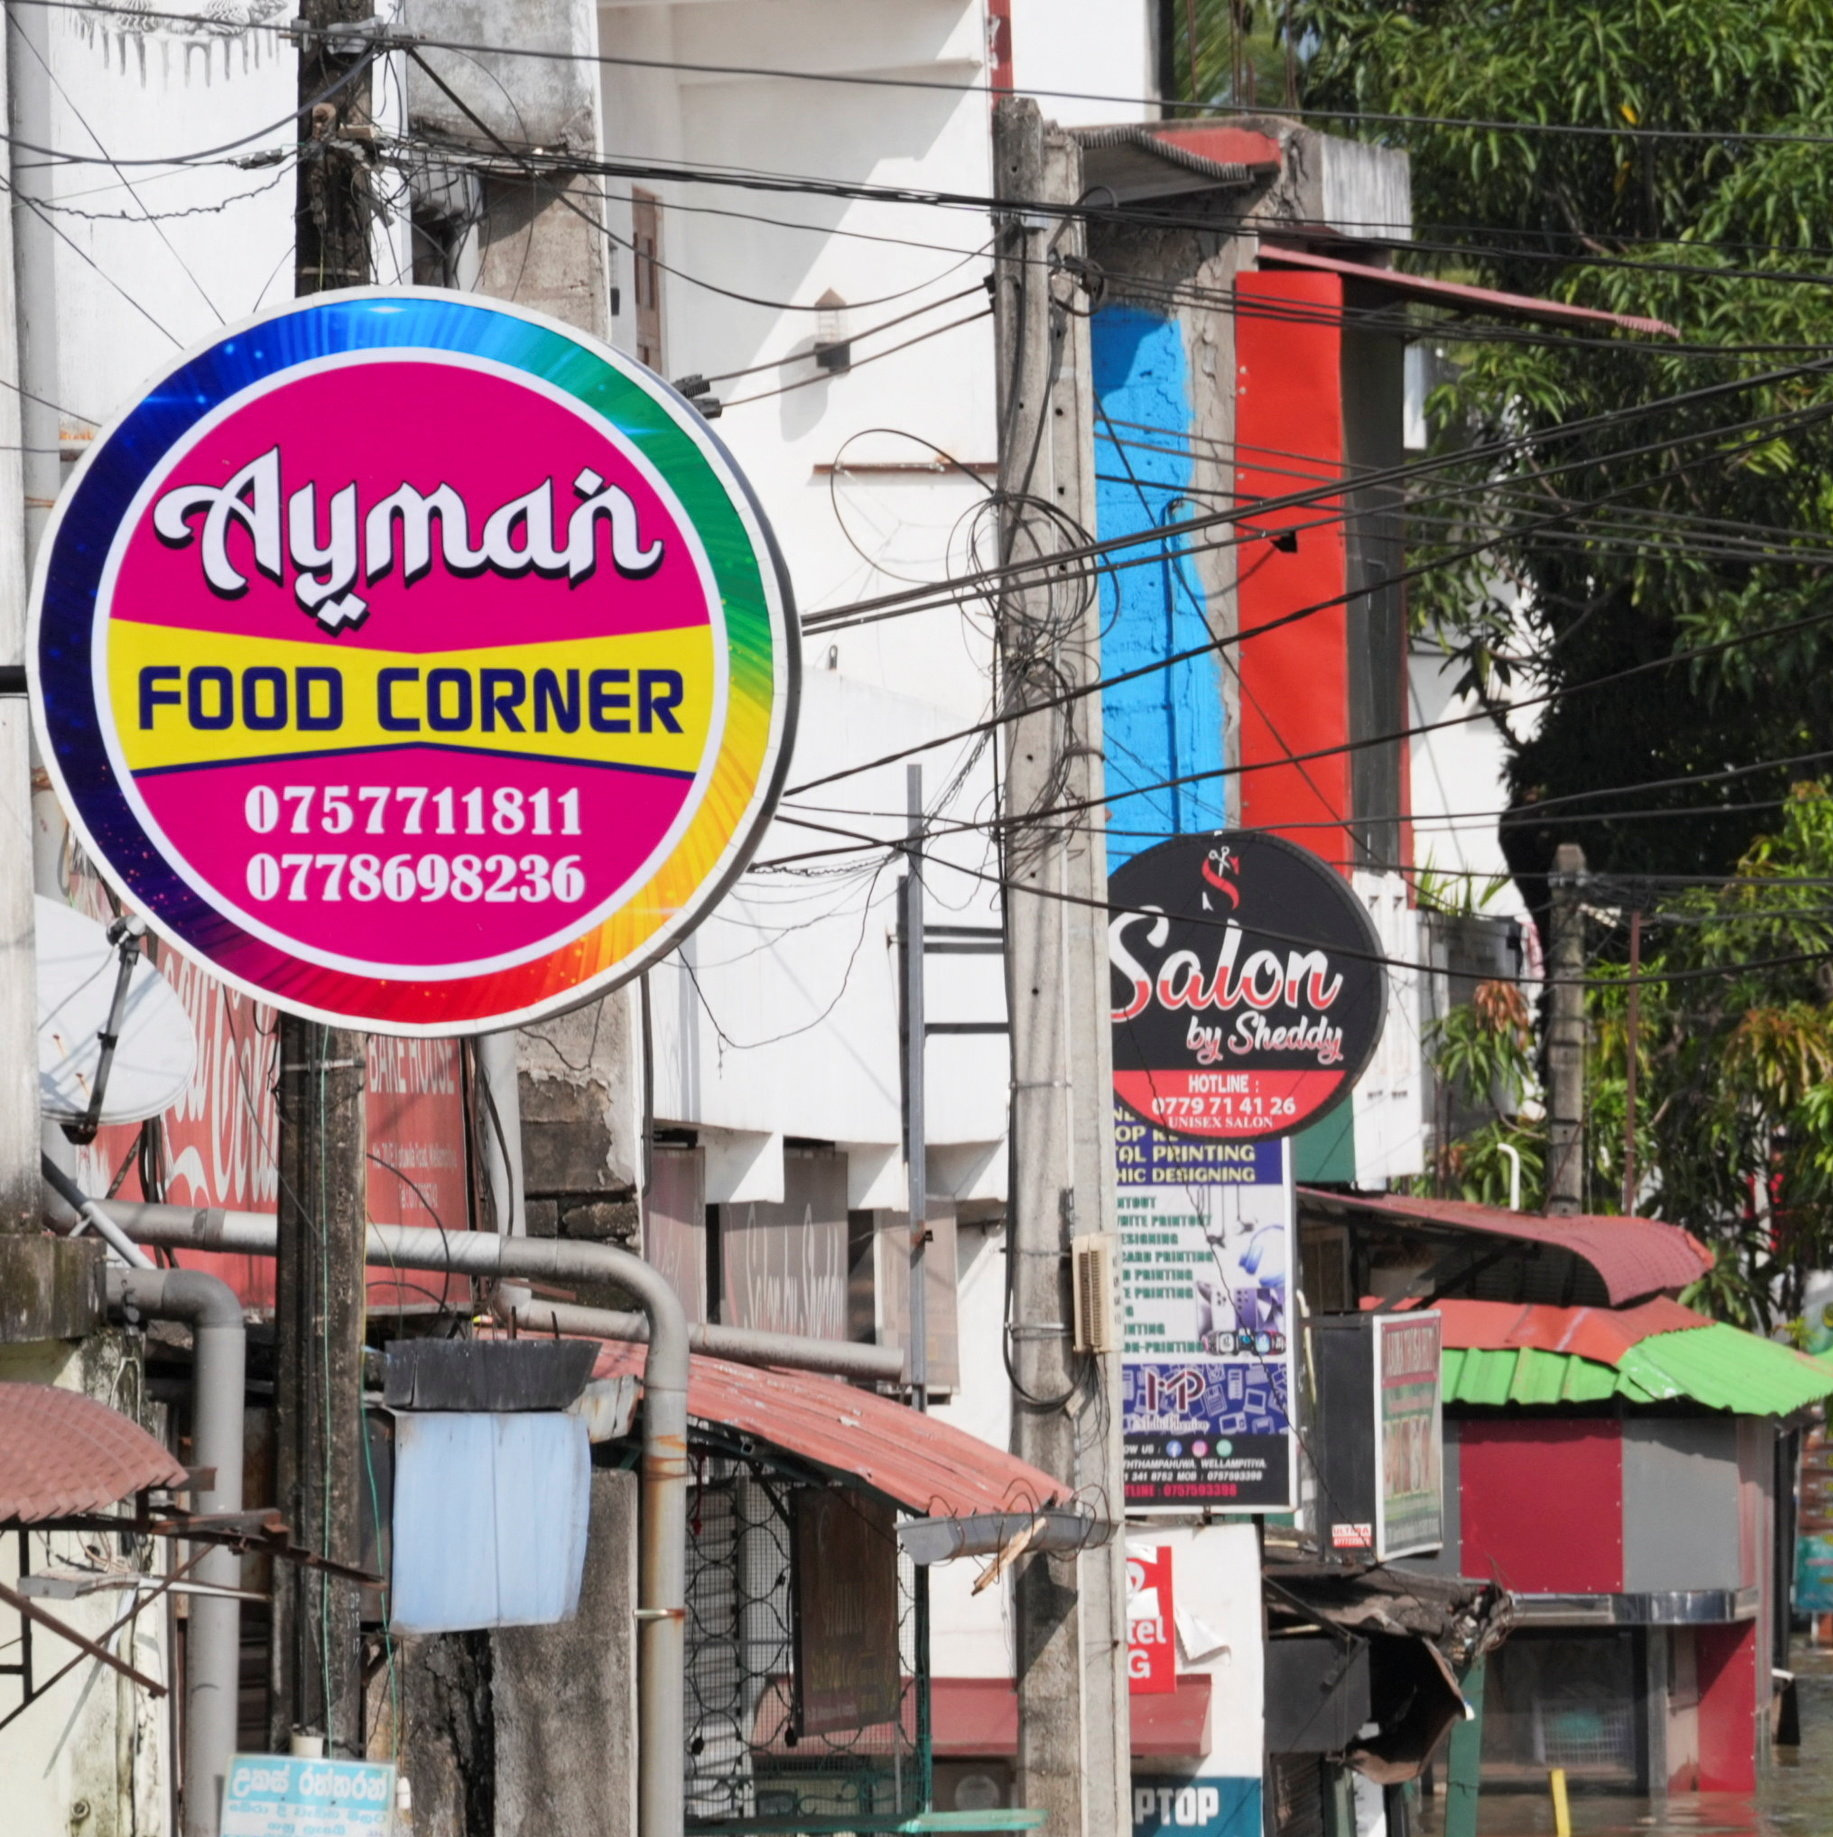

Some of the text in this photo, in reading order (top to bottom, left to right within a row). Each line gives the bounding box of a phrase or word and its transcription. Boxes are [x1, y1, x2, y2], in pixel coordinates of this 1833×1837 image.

[153, 445, 664, 635] Ayman
[138, 665, 685, 734] FOOD CORNER
[244, 784, 582, 836] 0757711811
[246, 853, 586, 904] 0778698236
[1109, 905, 1343, 1023] Salon
[1186, 1011, 1344, 1065] by Sheddy
[1188, 1075, 1249, 1093] HOTLINE
[1152, 1098, 1206, 1115] 0779
[1210, 1098, 1234, 1115] 71
[1240, 1098, 1264, 1115] 41
[1271, 1098, 1296, 1115] 26
[1169, 1116, 1274, 1129] UNISEX SALON
[1116, 1145, 1256, 1162] AL PRINTING
[1153, 1168, 1256, 1183] DESIGNING
[1155, 1251, 1214, 1263] PRINTING
[1135, 1269, 1193, 1281] PRINTING
[1135, 1287, 1194, 1299] PRINTING
[1135, 1787, 1219, 1825] PTOP
